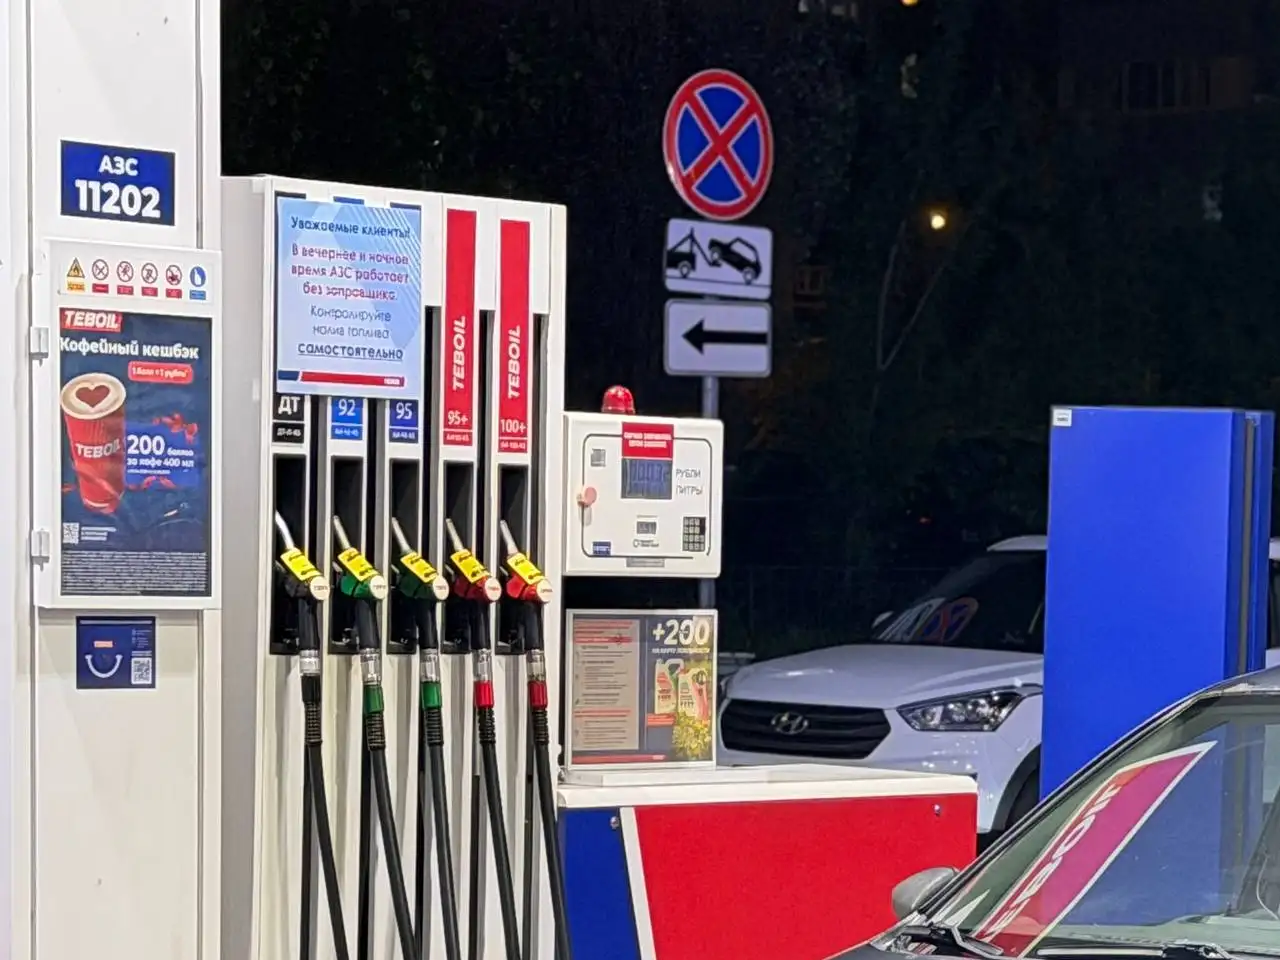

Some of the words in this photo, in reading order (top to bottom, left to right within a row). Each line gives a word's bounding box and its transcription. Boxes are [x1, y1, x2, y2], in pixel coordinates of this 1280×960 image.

[98, 155, 139, 176] АЗС
[74, 178, 161, 218] 11202
[291, 216, 359, 235] Уважаемые
[361, 225, 411, 239] клиенты!
[292, 243, 299, 256] В
[302, 246, 356, 261] вечернее
[359, 251, 366, 262] и
[369, 253, 409, 266] ночное
[291, 265, 326, 278] время
[329, 265, 353, 279] АЗС
[355, 268, 409, 284] работает
[303, 281, 323, 296] без
[63, 311, 119, 329] TEBOIL
[310, 305, 392, 322] Контролируйте
[312, 325, 345, 337] налив
[348, 327, 389, 340] топлива
[60, 337, 139, 356] Кофейный
[142, 343, 199, 360] кешбэк
[297, 343, 404, 361] самостоятельно
[452, 315, 467, 392] TEBOIL
[507, 325, 521, 400] TEBOIL
[278, 395, 301, 415] ДТ
[338, 398, 356, 416] 92
[396, 402, 413, 420] 95
[447, 410, 469, 426] 95+
[500, 418, 527, 434] 100+
[75, 439, 121, 459] TEBOIL
[127, 434, 165, 456] 200
[139, 457, 162, 468] кофе
[163, 458, 180, 467] 400
[181, 459, 195, 468] мл
[675, 468, 701, 479] РУБЛИ
[652, 619, 711, 646] +200
